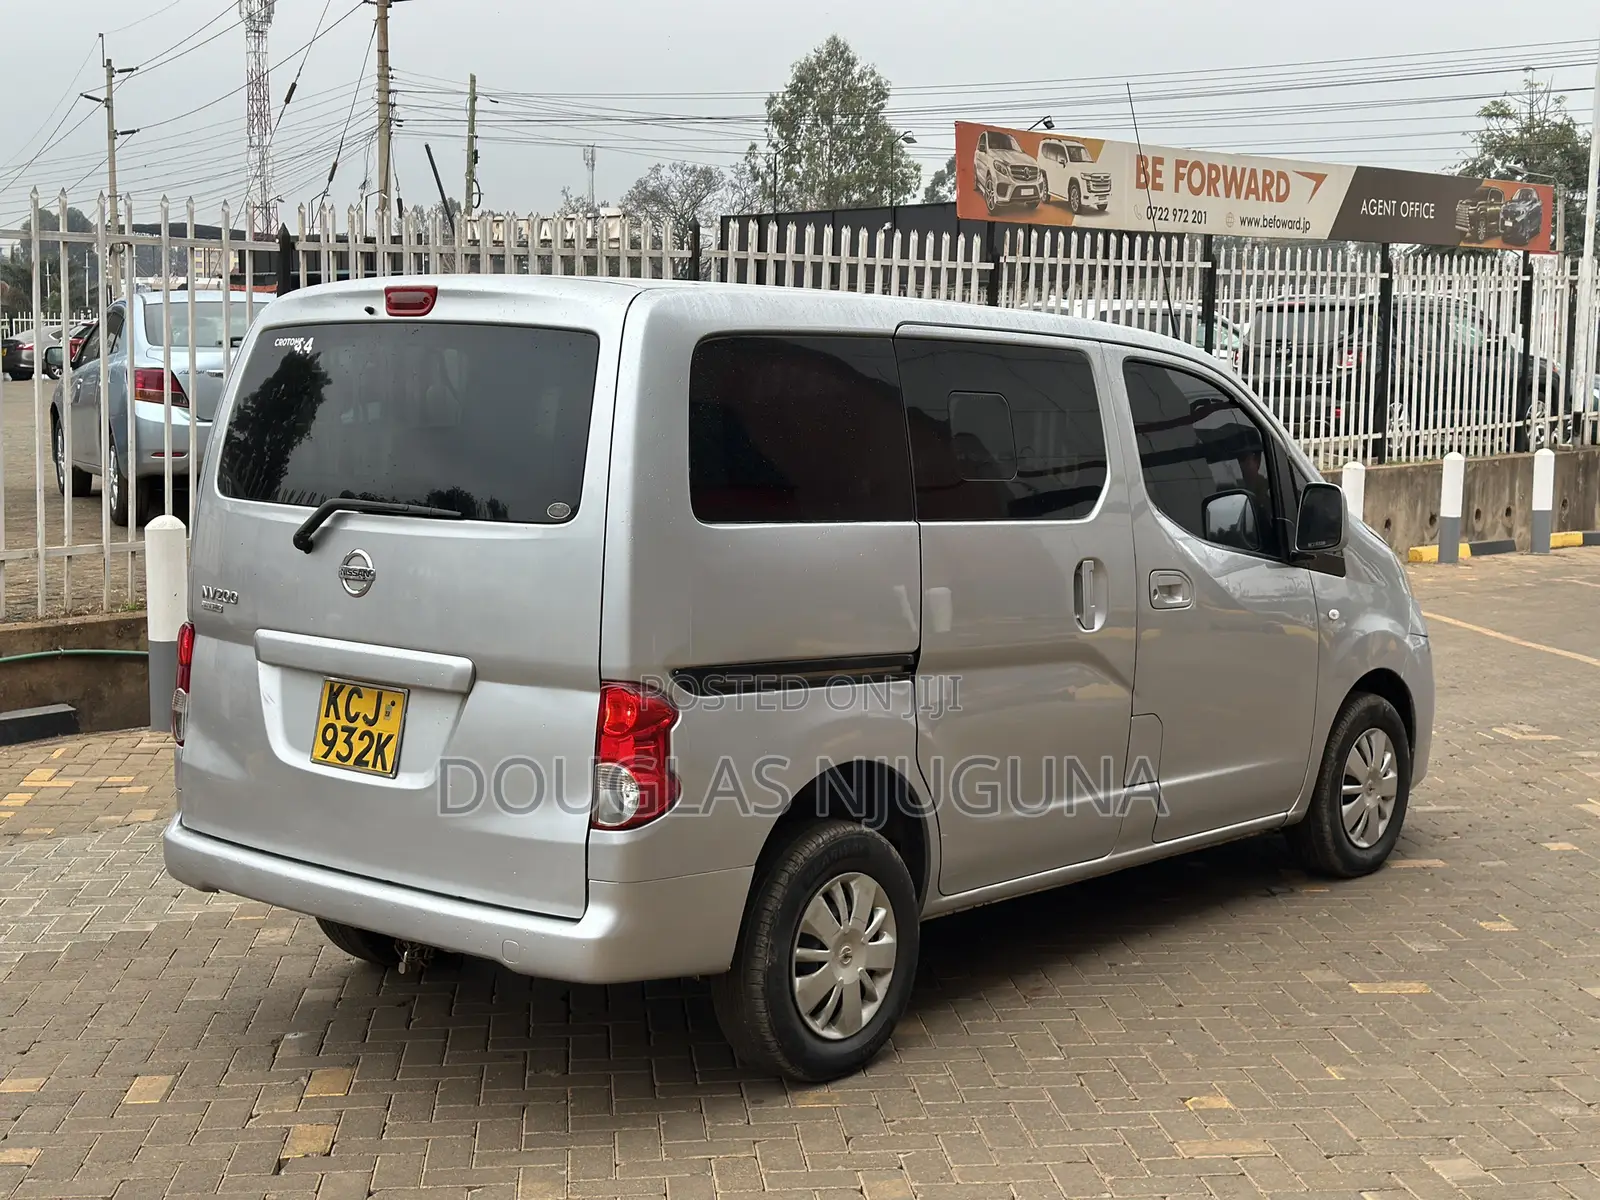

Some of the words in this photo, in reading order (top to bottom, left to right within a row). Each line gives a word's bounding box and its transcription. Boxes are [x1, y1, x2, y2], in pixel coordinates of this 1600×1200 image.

[1135, 154, 1165, 192] BE
[1174, 158, 1291, 204] FORWARD
[1146, 205, 1169, 222] 0722
[1172, 208, 1189, 223] 972
[1191, 210, 1208, 225] 201
[1360, 198, 1397, 216] AGENT
[1400, 200, 1435, 219] OFFICE
[1239, 214, 1311, 234] www.befoward.jp
[340, 568, 371, 580] NISSAN
[201, 585, 239, 605] NV200
[324, 683, 384, 727] KCJ
[321, 722, 395, 772] 932K
